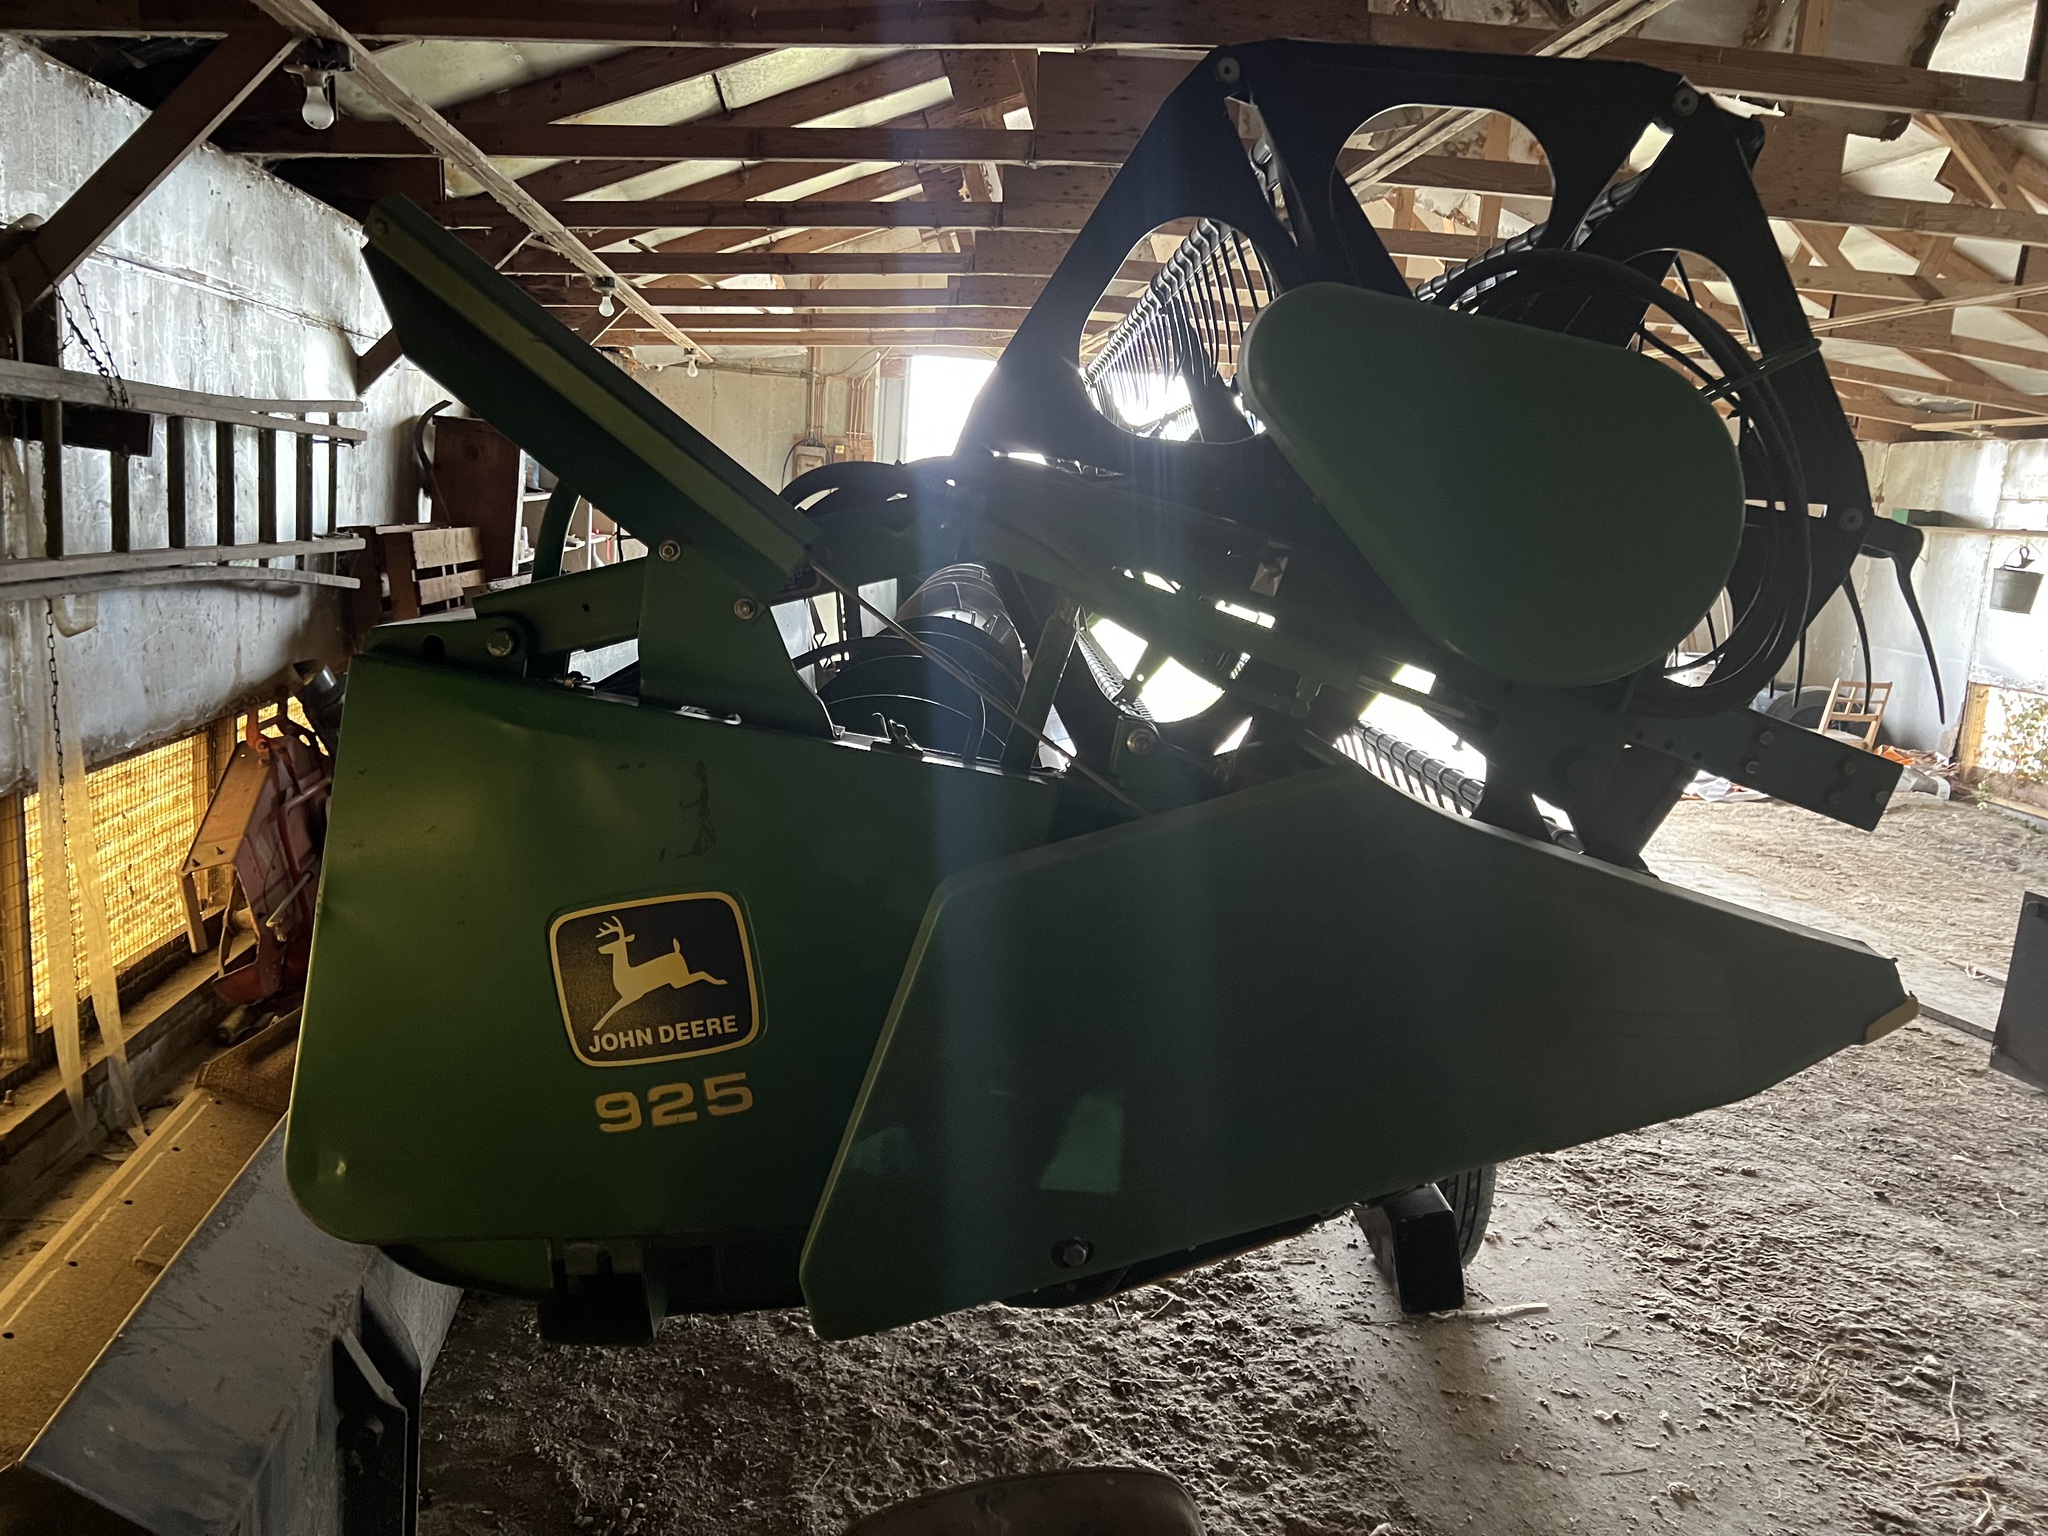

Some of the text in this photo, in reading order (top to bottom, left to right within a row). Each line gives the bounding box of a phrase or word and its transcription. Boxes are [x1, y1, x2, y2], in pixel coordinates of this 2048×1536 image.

[589, 1015, 738, 1053] JOHN DEERE
[595, 1072, 754, 1133] 925
